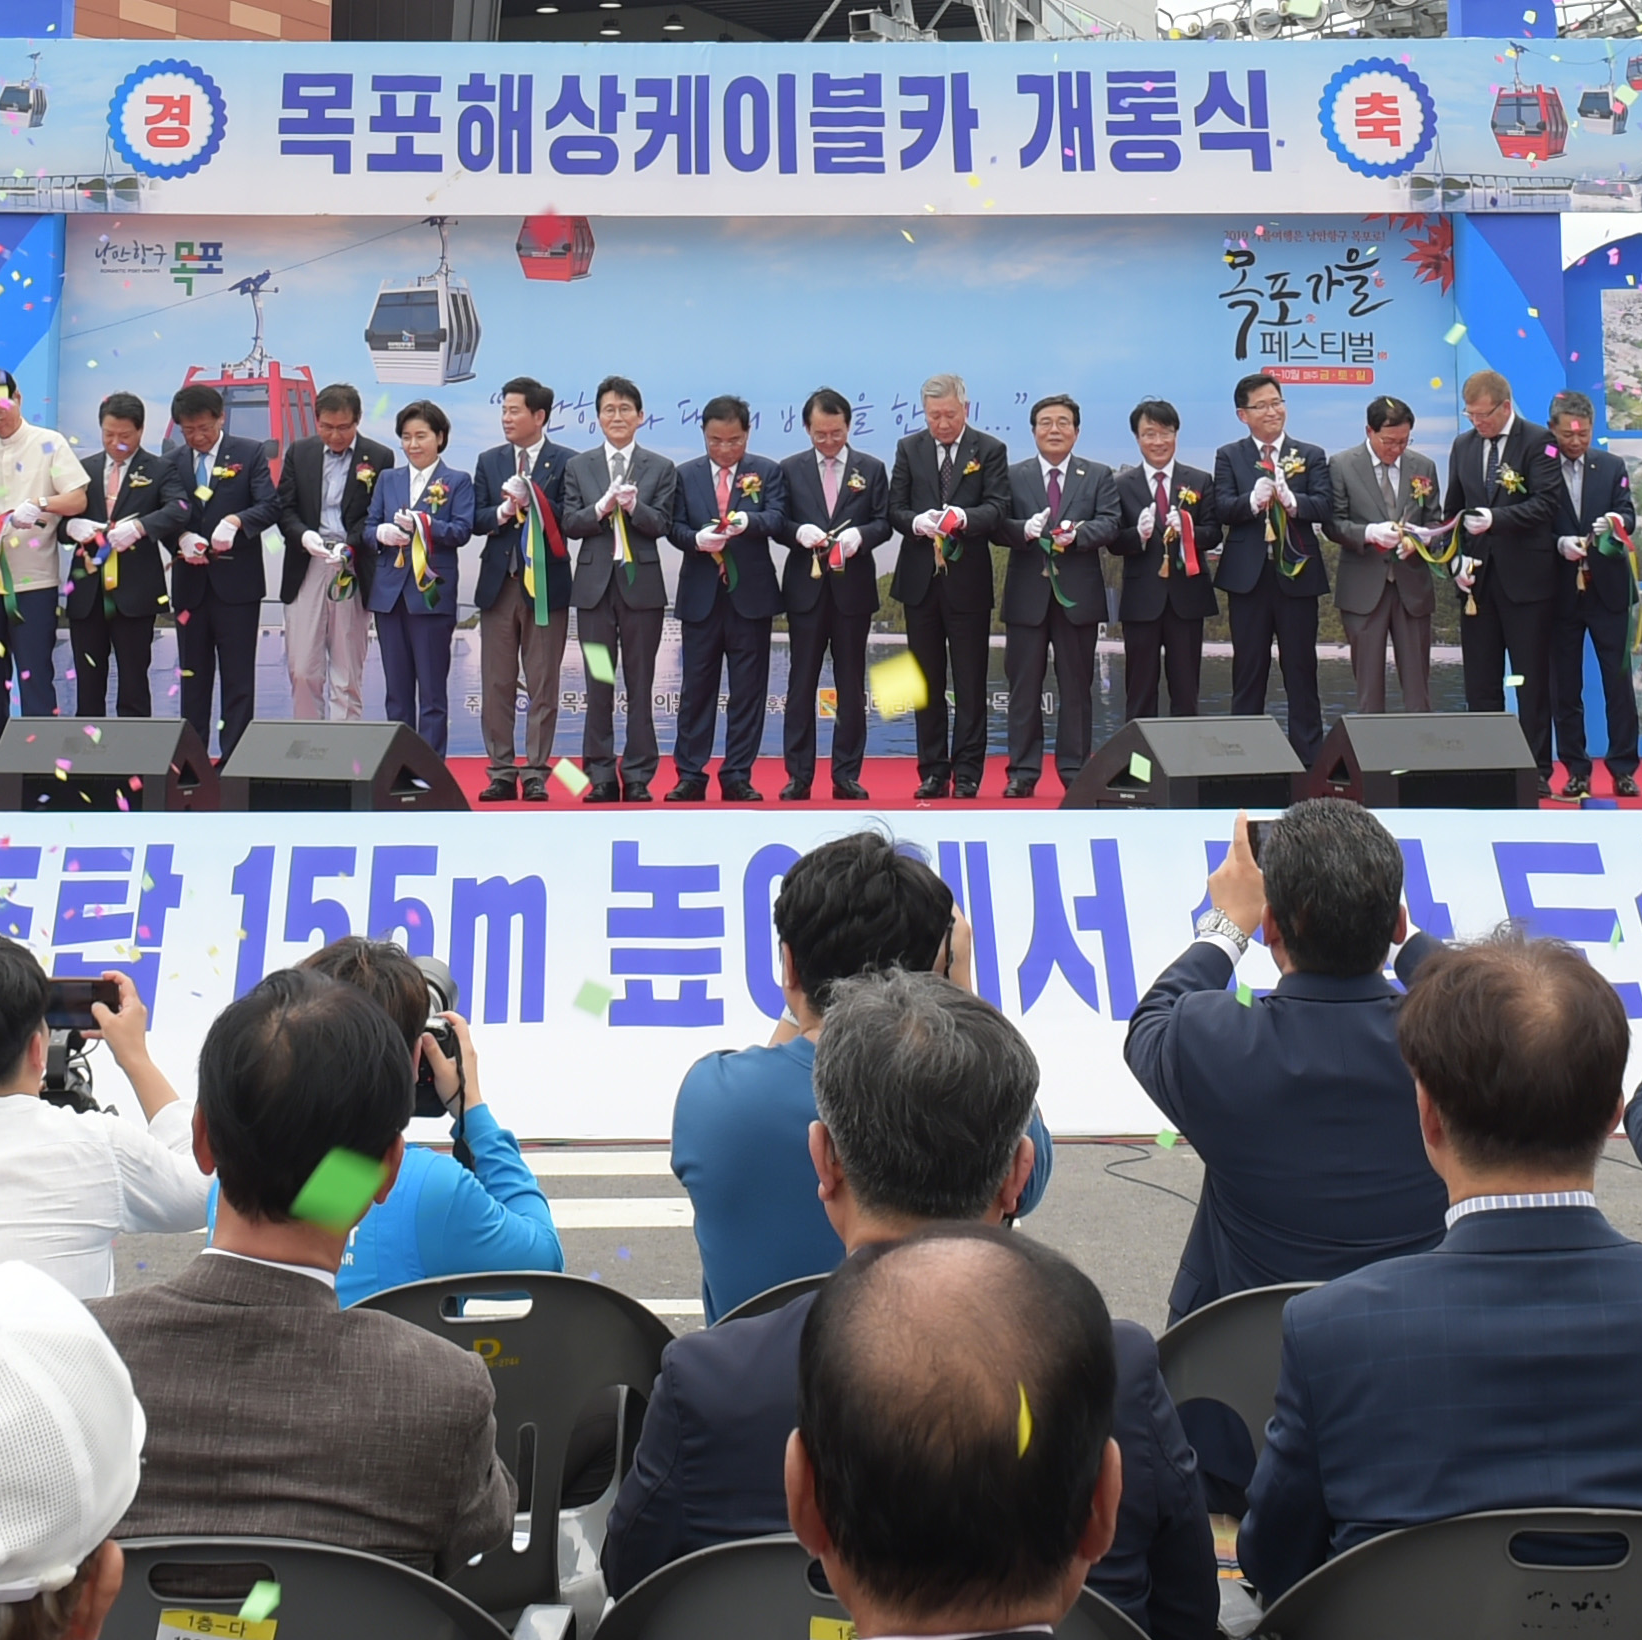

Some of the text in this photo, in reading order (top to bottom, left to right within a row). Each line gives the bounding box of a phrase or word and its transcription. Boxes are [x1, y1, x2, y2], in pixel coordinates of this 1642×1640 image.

[143, 69, 1401, 175] 경 목포해상케이블카 개통식 축
[95, 240, 224, 297] 낭만항구 목포
[1260, 331, 1375, 363] 페스티벌
[231, 845, 547, 1025] 155m
[188, 1614, 247, 1638] 1층-다
